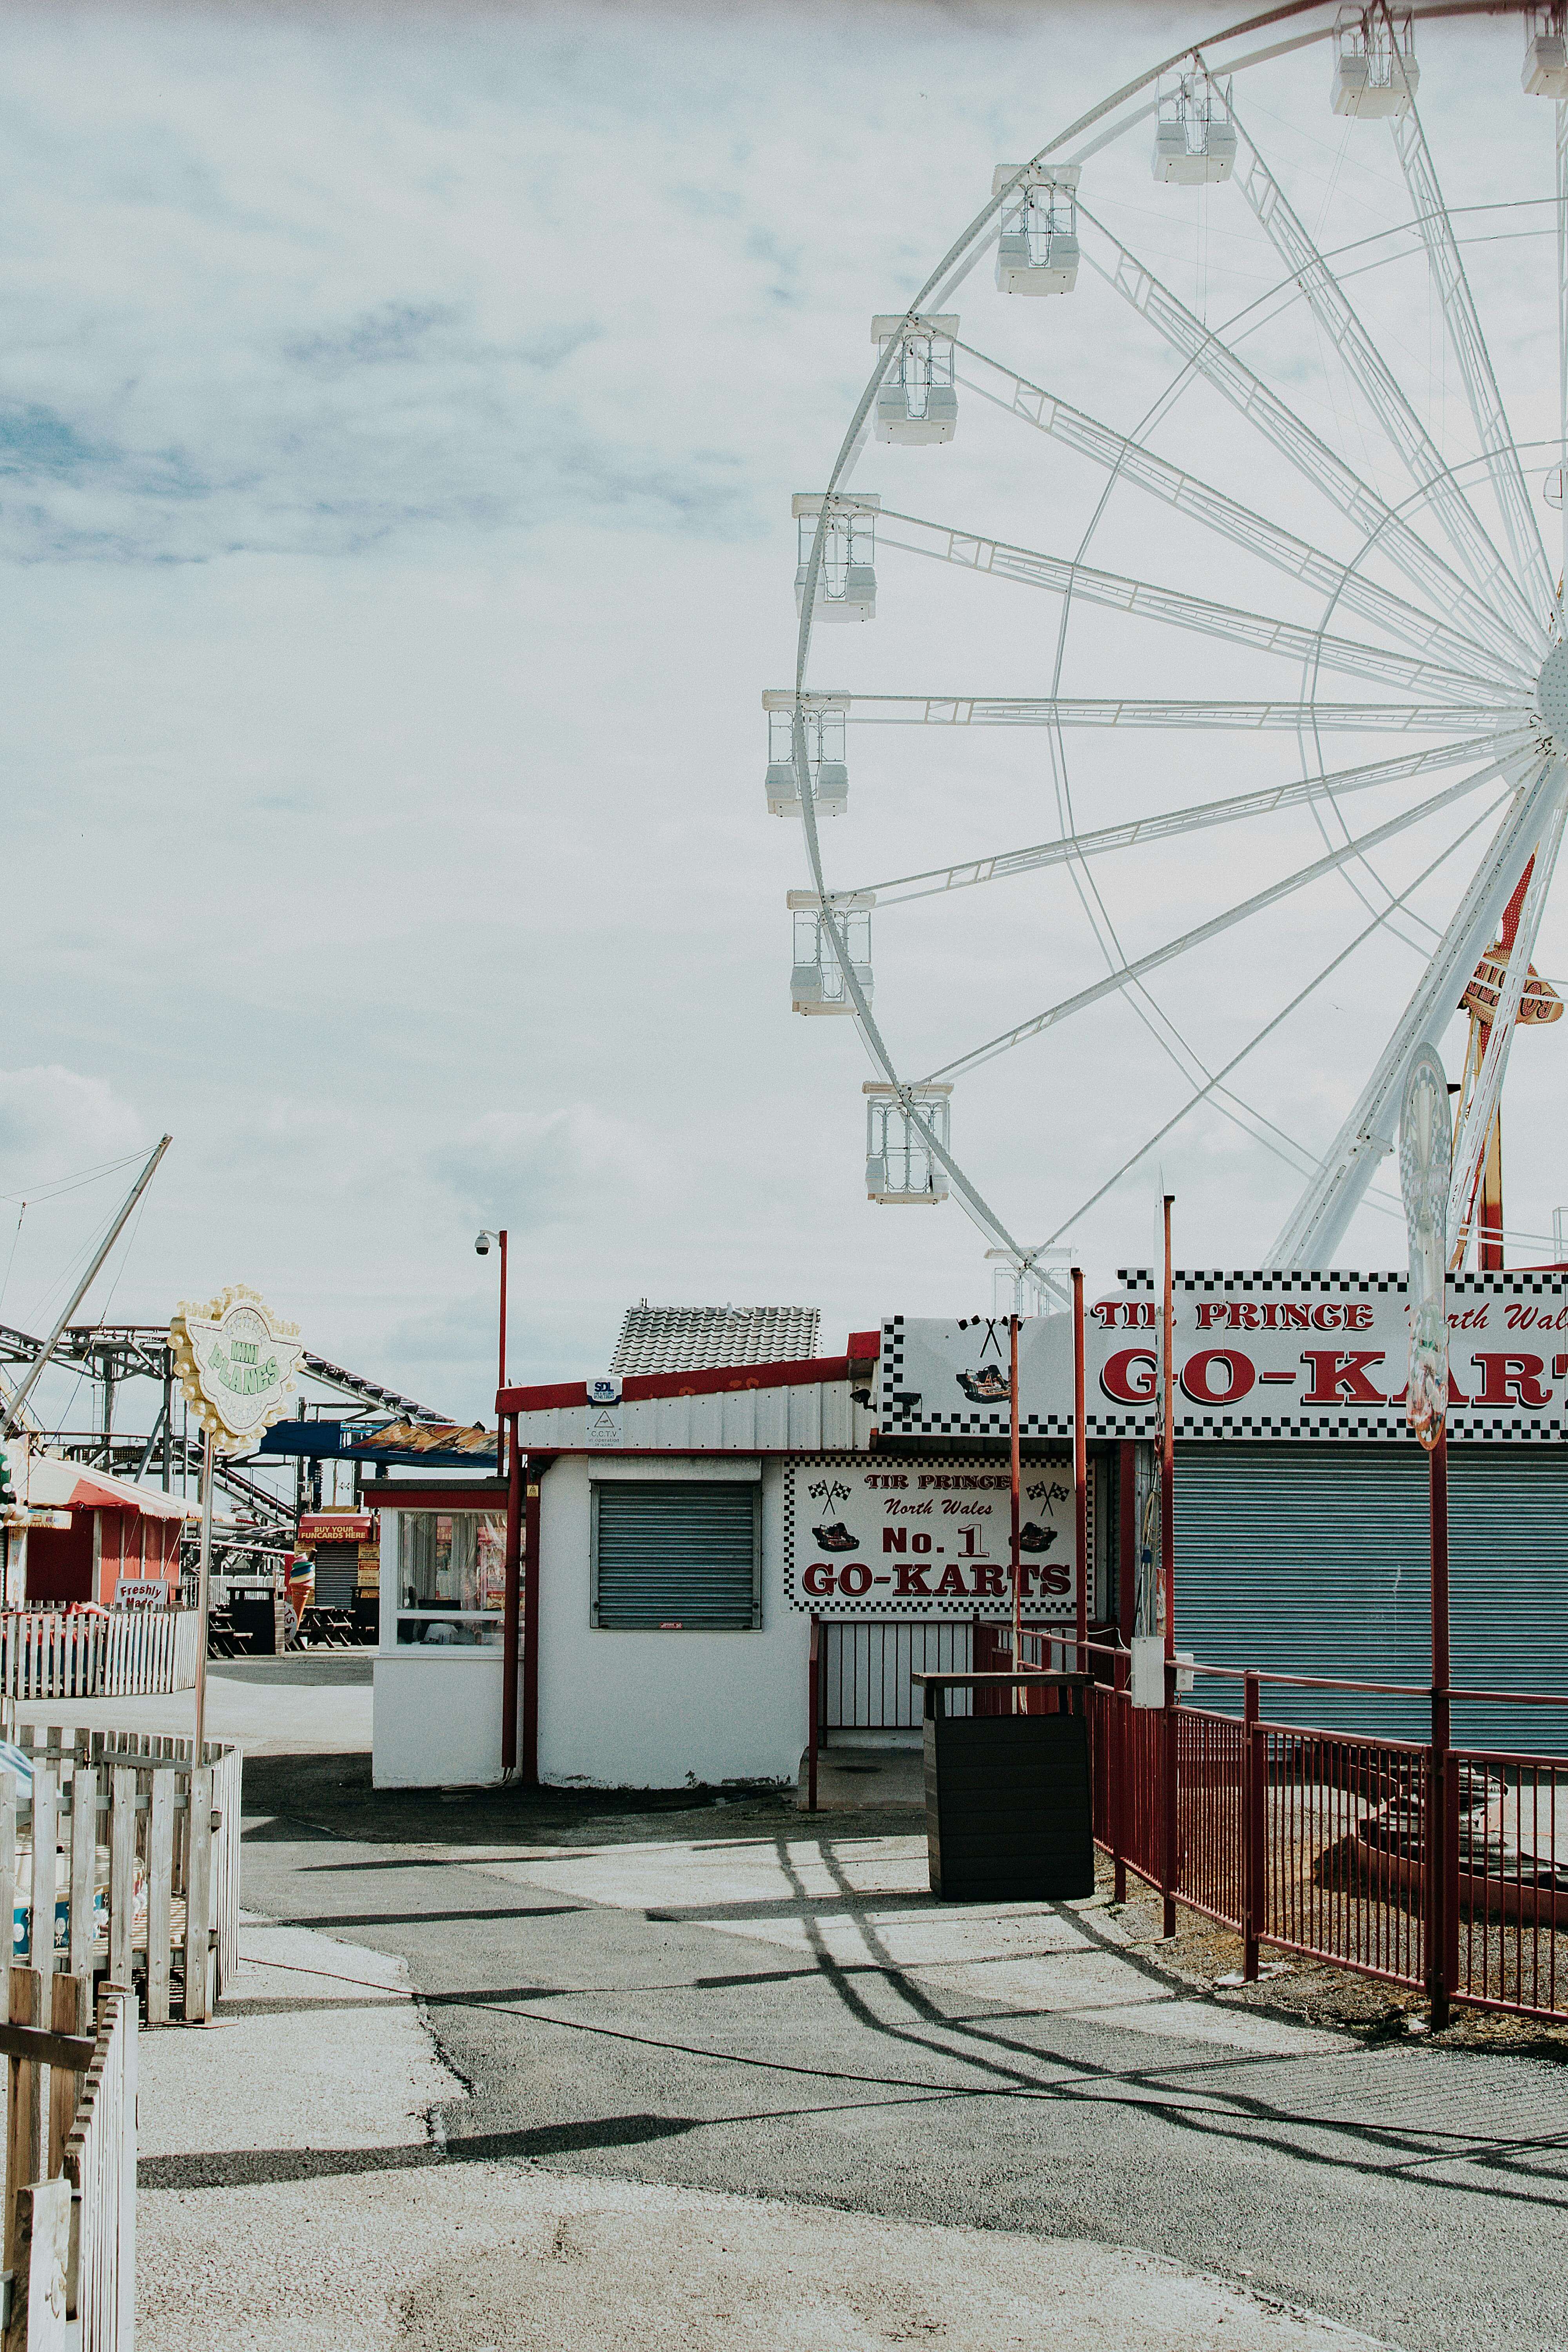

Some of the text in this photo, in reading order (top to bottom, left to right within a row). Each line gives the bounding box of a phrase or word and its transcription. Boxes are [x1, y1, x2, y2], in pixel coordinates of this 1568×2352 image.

[1404, 1303, 1568, 1330] rth Wal
[230, 1340, 259, 1365] MINI
[208, 1343, 280, 1395] PLANES
[594, 1382, 614, 1392] SDL
[864, 1474, 909, 1489] TIR
[884, 1498, 993, 1515] North Wales
[883, 1524, 989, 1557] No. 1
[120, 1584, 162, 1599] Freshly
[802, 1563, 1071, 1597] GO-KARTS
